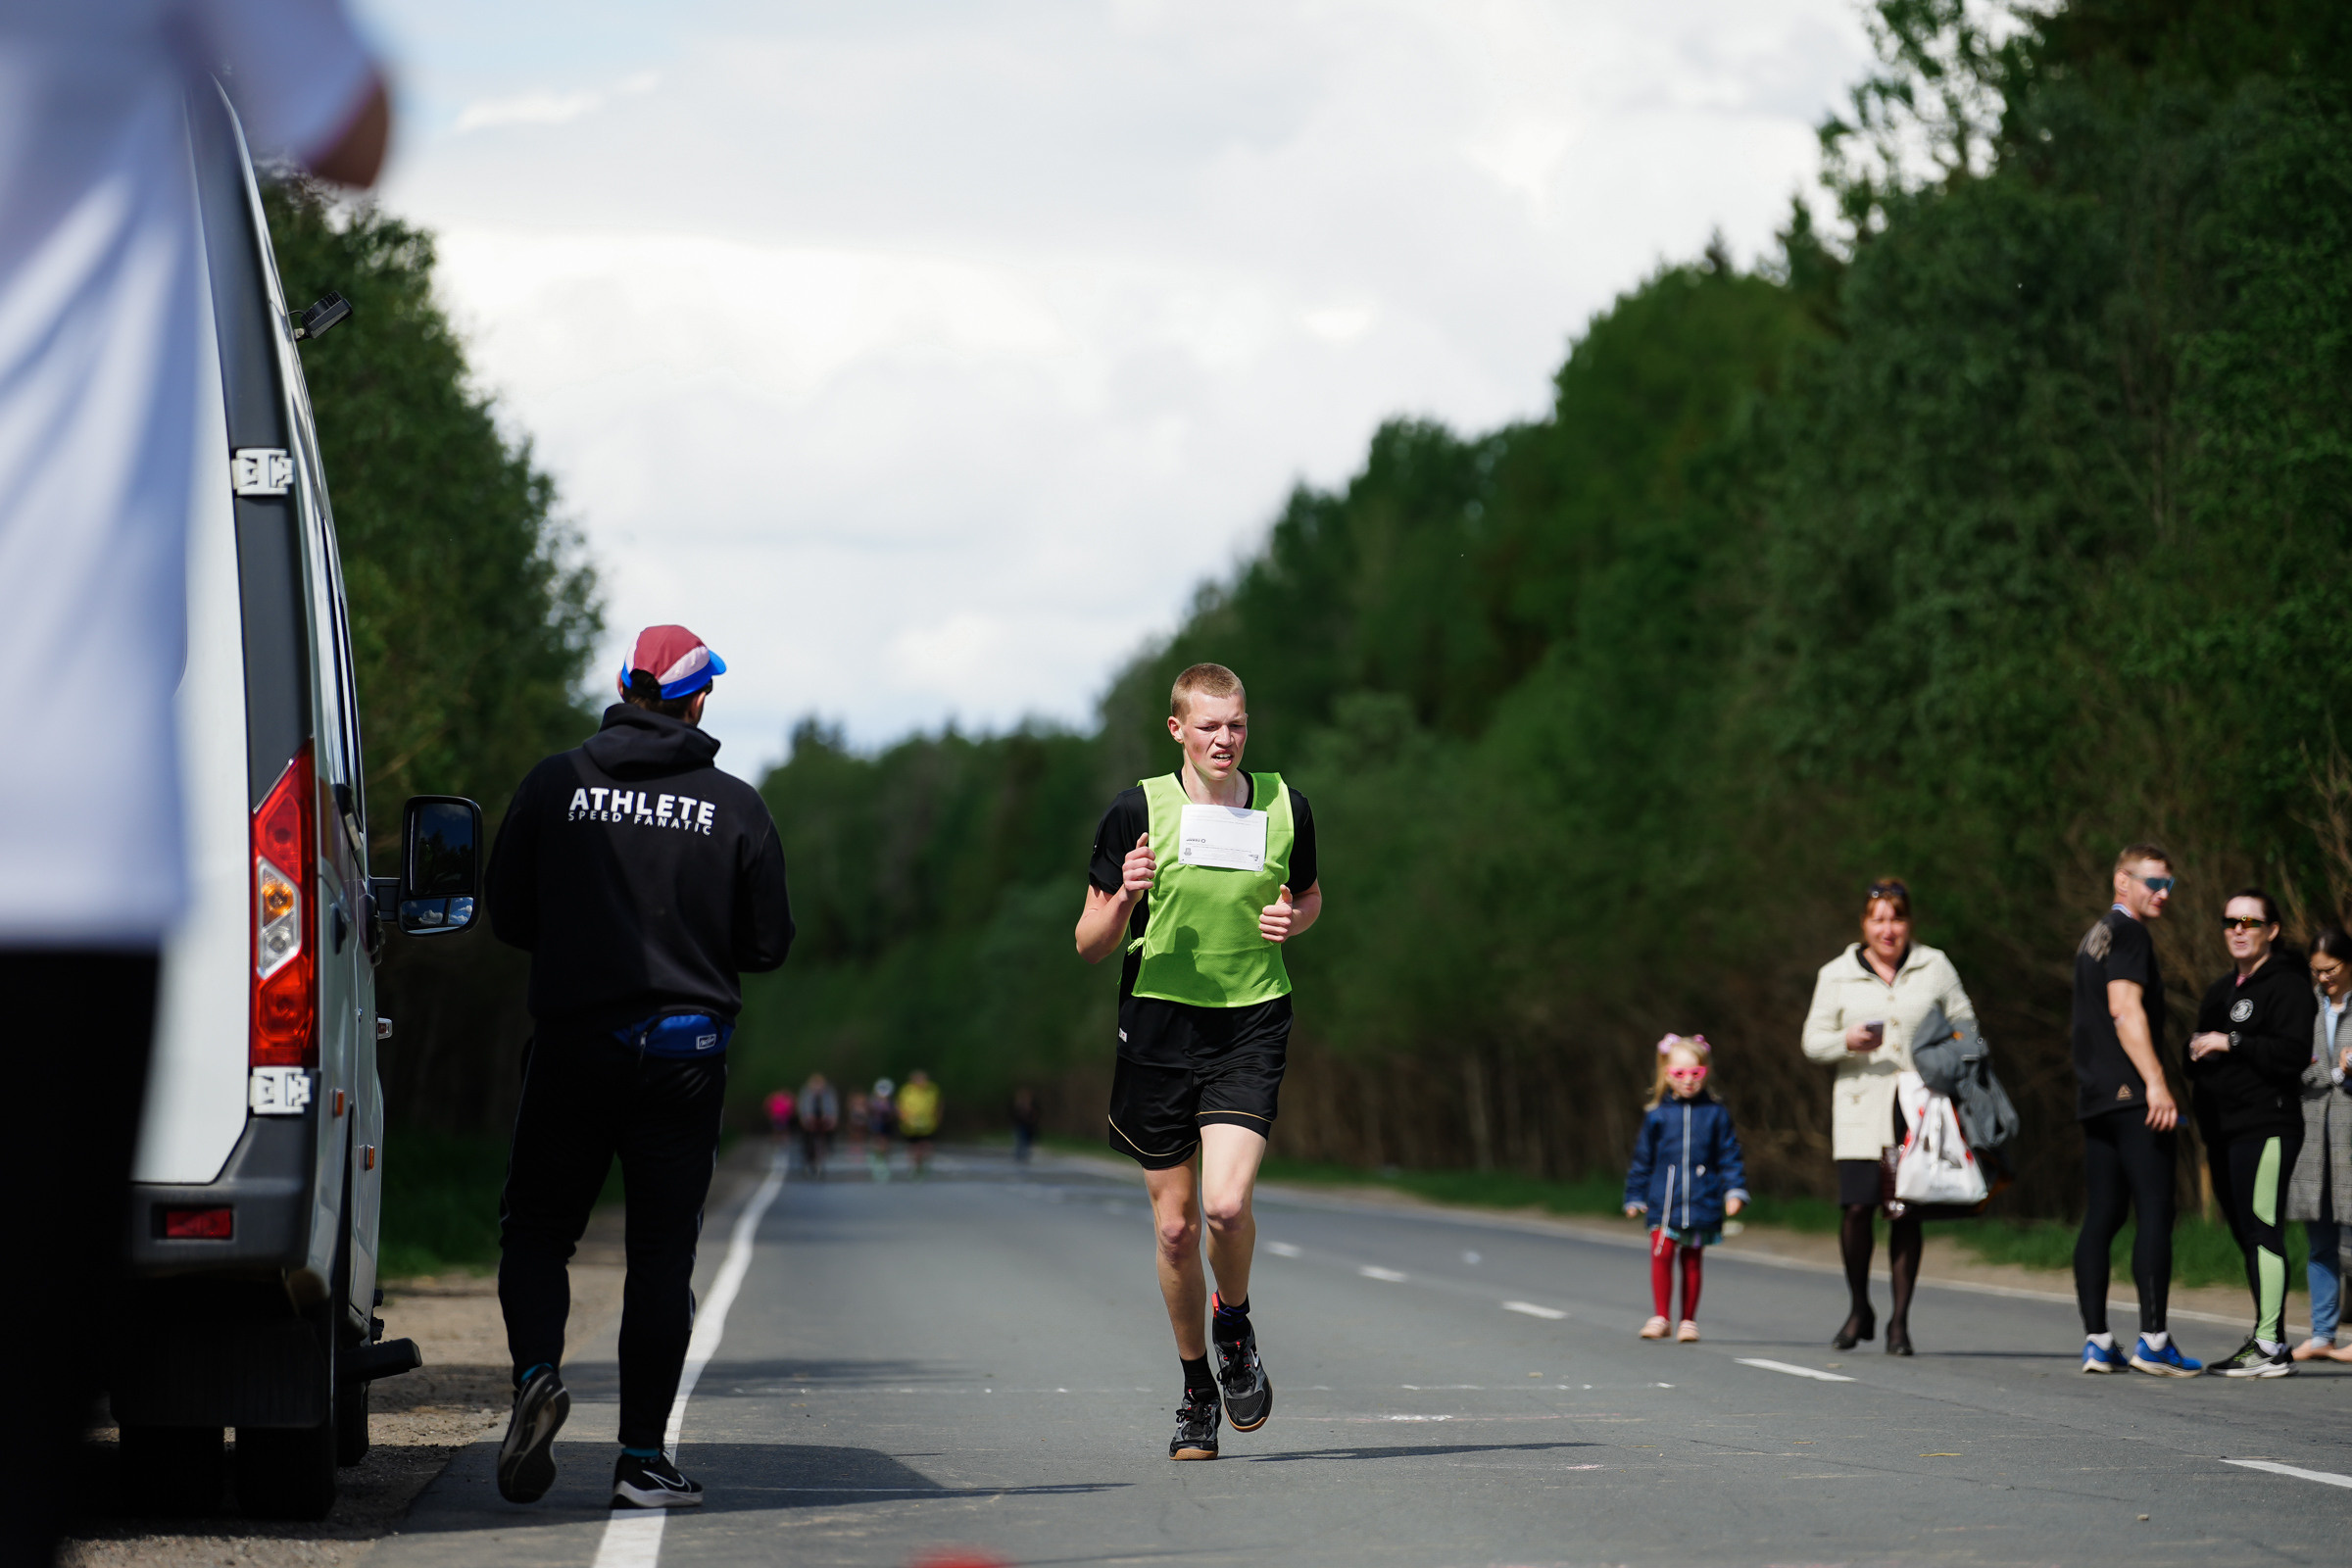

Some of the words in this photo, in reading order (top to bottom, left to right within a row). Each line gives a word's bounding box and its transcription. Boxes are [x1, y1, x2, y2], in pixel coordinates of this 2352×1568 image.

[567, 809, 622, 823] SPEED
[633, 814, 711, 836] FANATIC
[568, 787, 715, 826] ATHLETE
